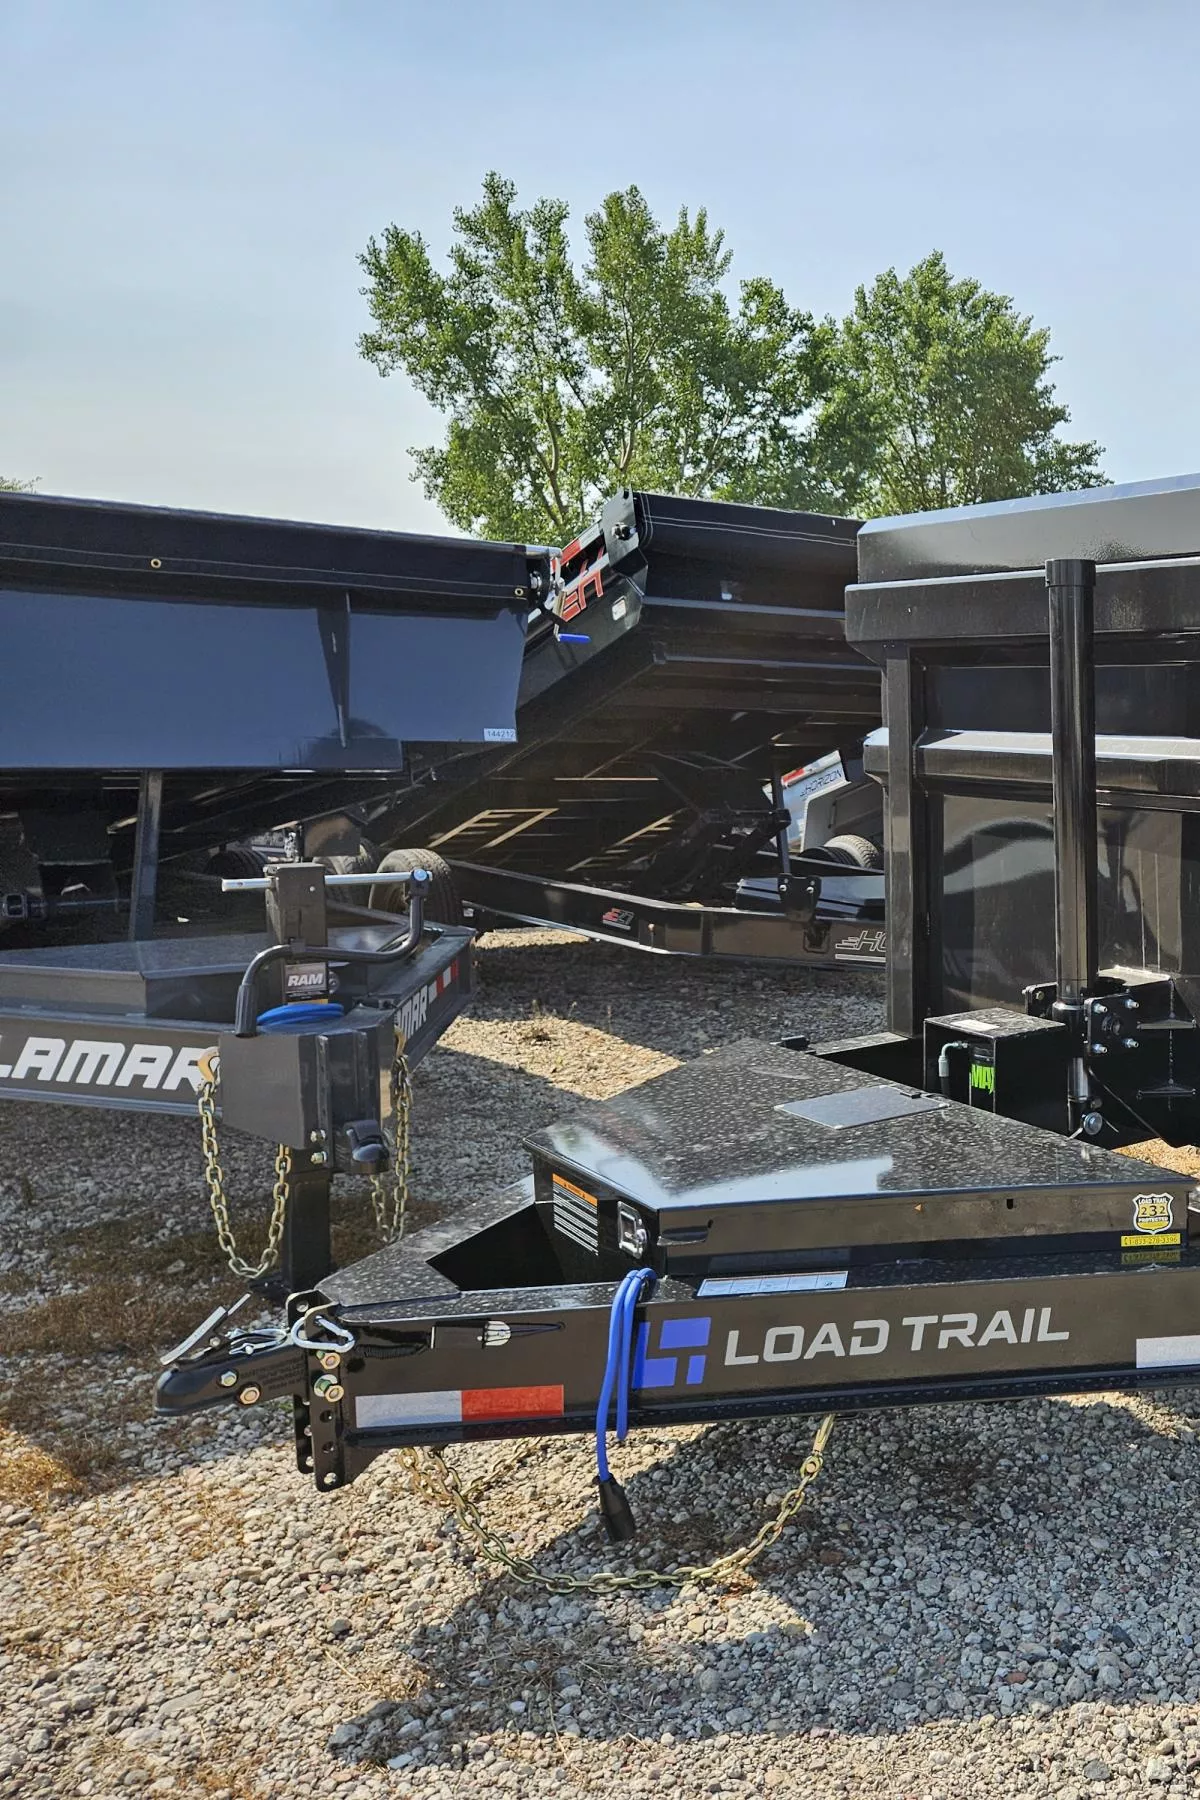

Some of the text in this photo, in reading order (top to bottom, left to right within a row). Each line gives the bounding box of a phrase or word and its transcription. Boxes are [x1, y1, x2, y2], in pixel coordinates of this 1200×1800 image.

[287, 972, 324, 987] RAM
[0, 1035, 217, 1092] AMAR
[723, 1306, 1070, 1366] LOAD TRAIL
